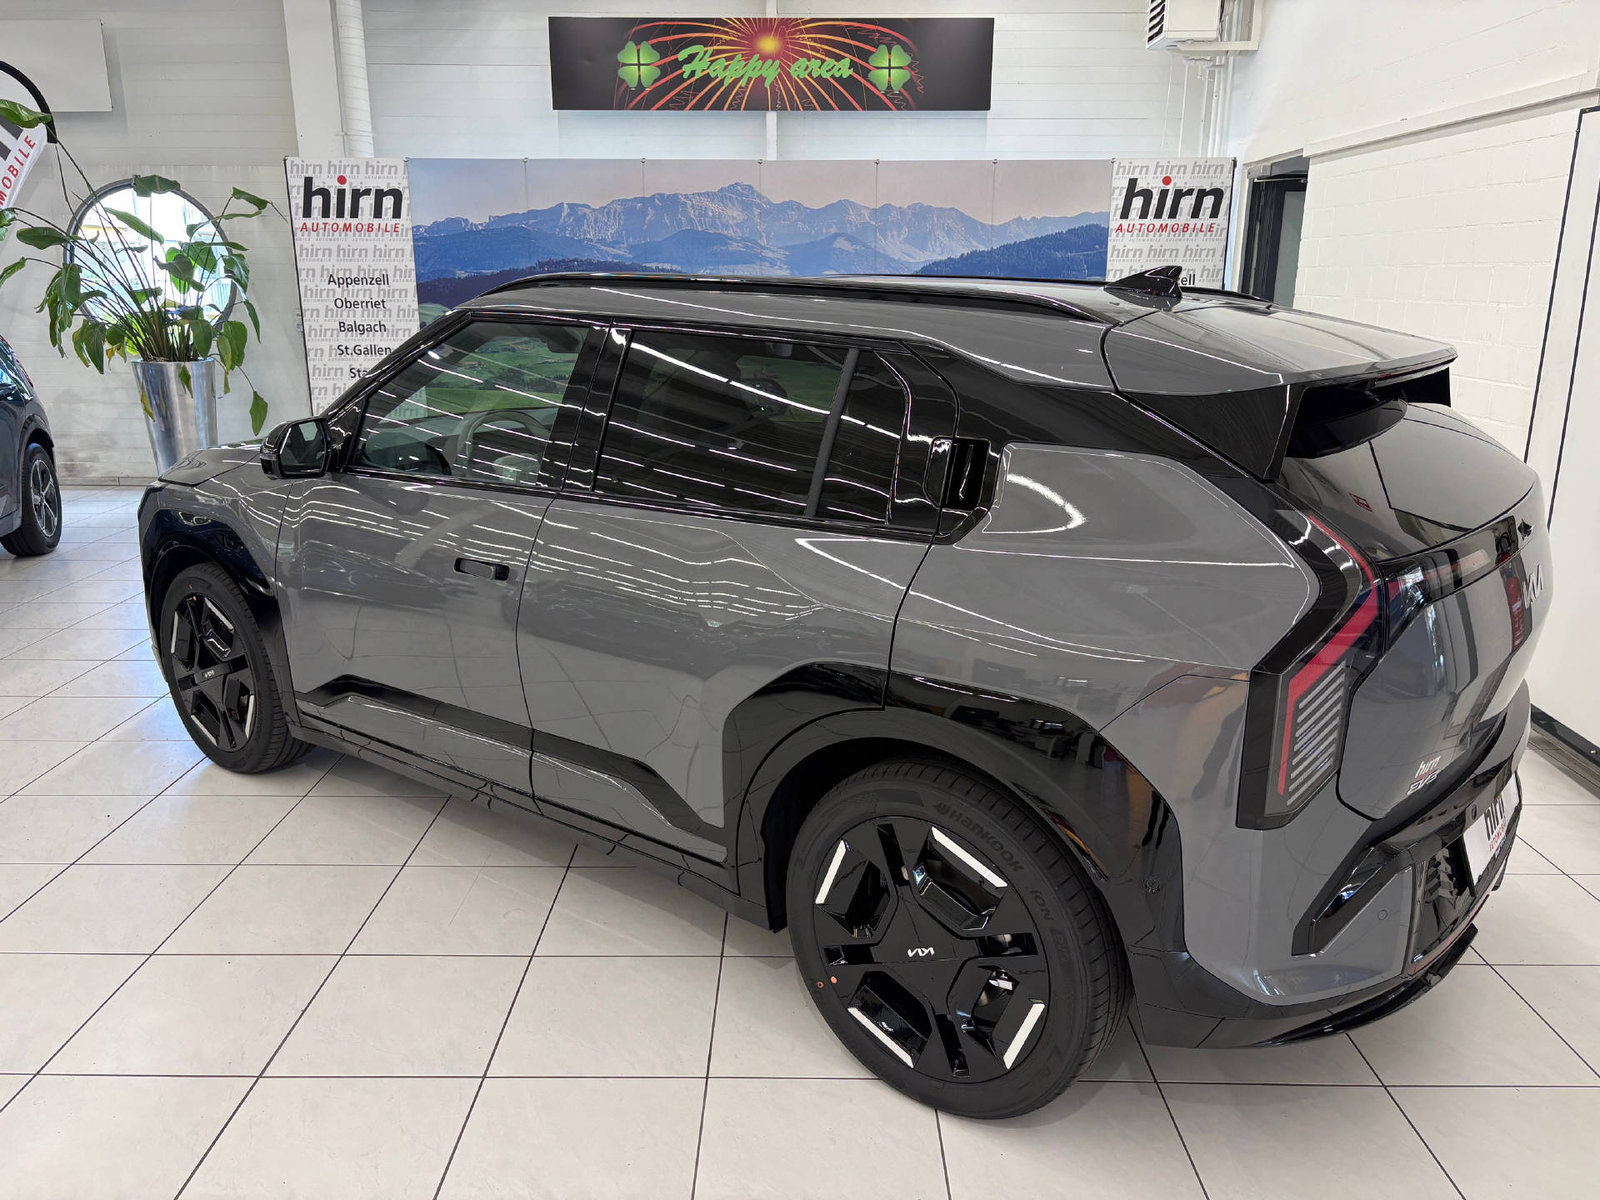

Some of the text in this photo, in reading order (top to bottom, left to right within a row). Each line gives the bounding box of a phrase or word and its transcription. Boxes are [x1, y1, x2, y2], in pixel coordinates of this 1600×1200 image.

[678, 44, 854, 88] Happy area
[0, 136, 36, 206] MOBILE
[290, 160, 322, 174] hirn
[328, 160, 360, 174] hirn
[365, 160, 398, 175] hirn
[1116, 160, 1224, 176] hirn hirn hirn
[302, 175, 402, 218] hirn
[1120, 176, 1224, 220] hirn
[300, 222, 400, 232] AUTOMOBILE
[1115, 222, 1216, 234] AUTOMOBILE
[300, 244, 404, 258] hirn hirn hirn
[1110, 244, 1216, 258] hirn hirn hirn
[328, 274, 390, 288] Appenzell
[304, 285, 336, 298] hirn
[377, 285, 409, 299] hirn
[334, 297, 386, 309] Oberriet
[338, 320, 387, 335] Balgach
[337, 344, 392, 356] St.Gallen
[312, 364, 344, 377] hirn
